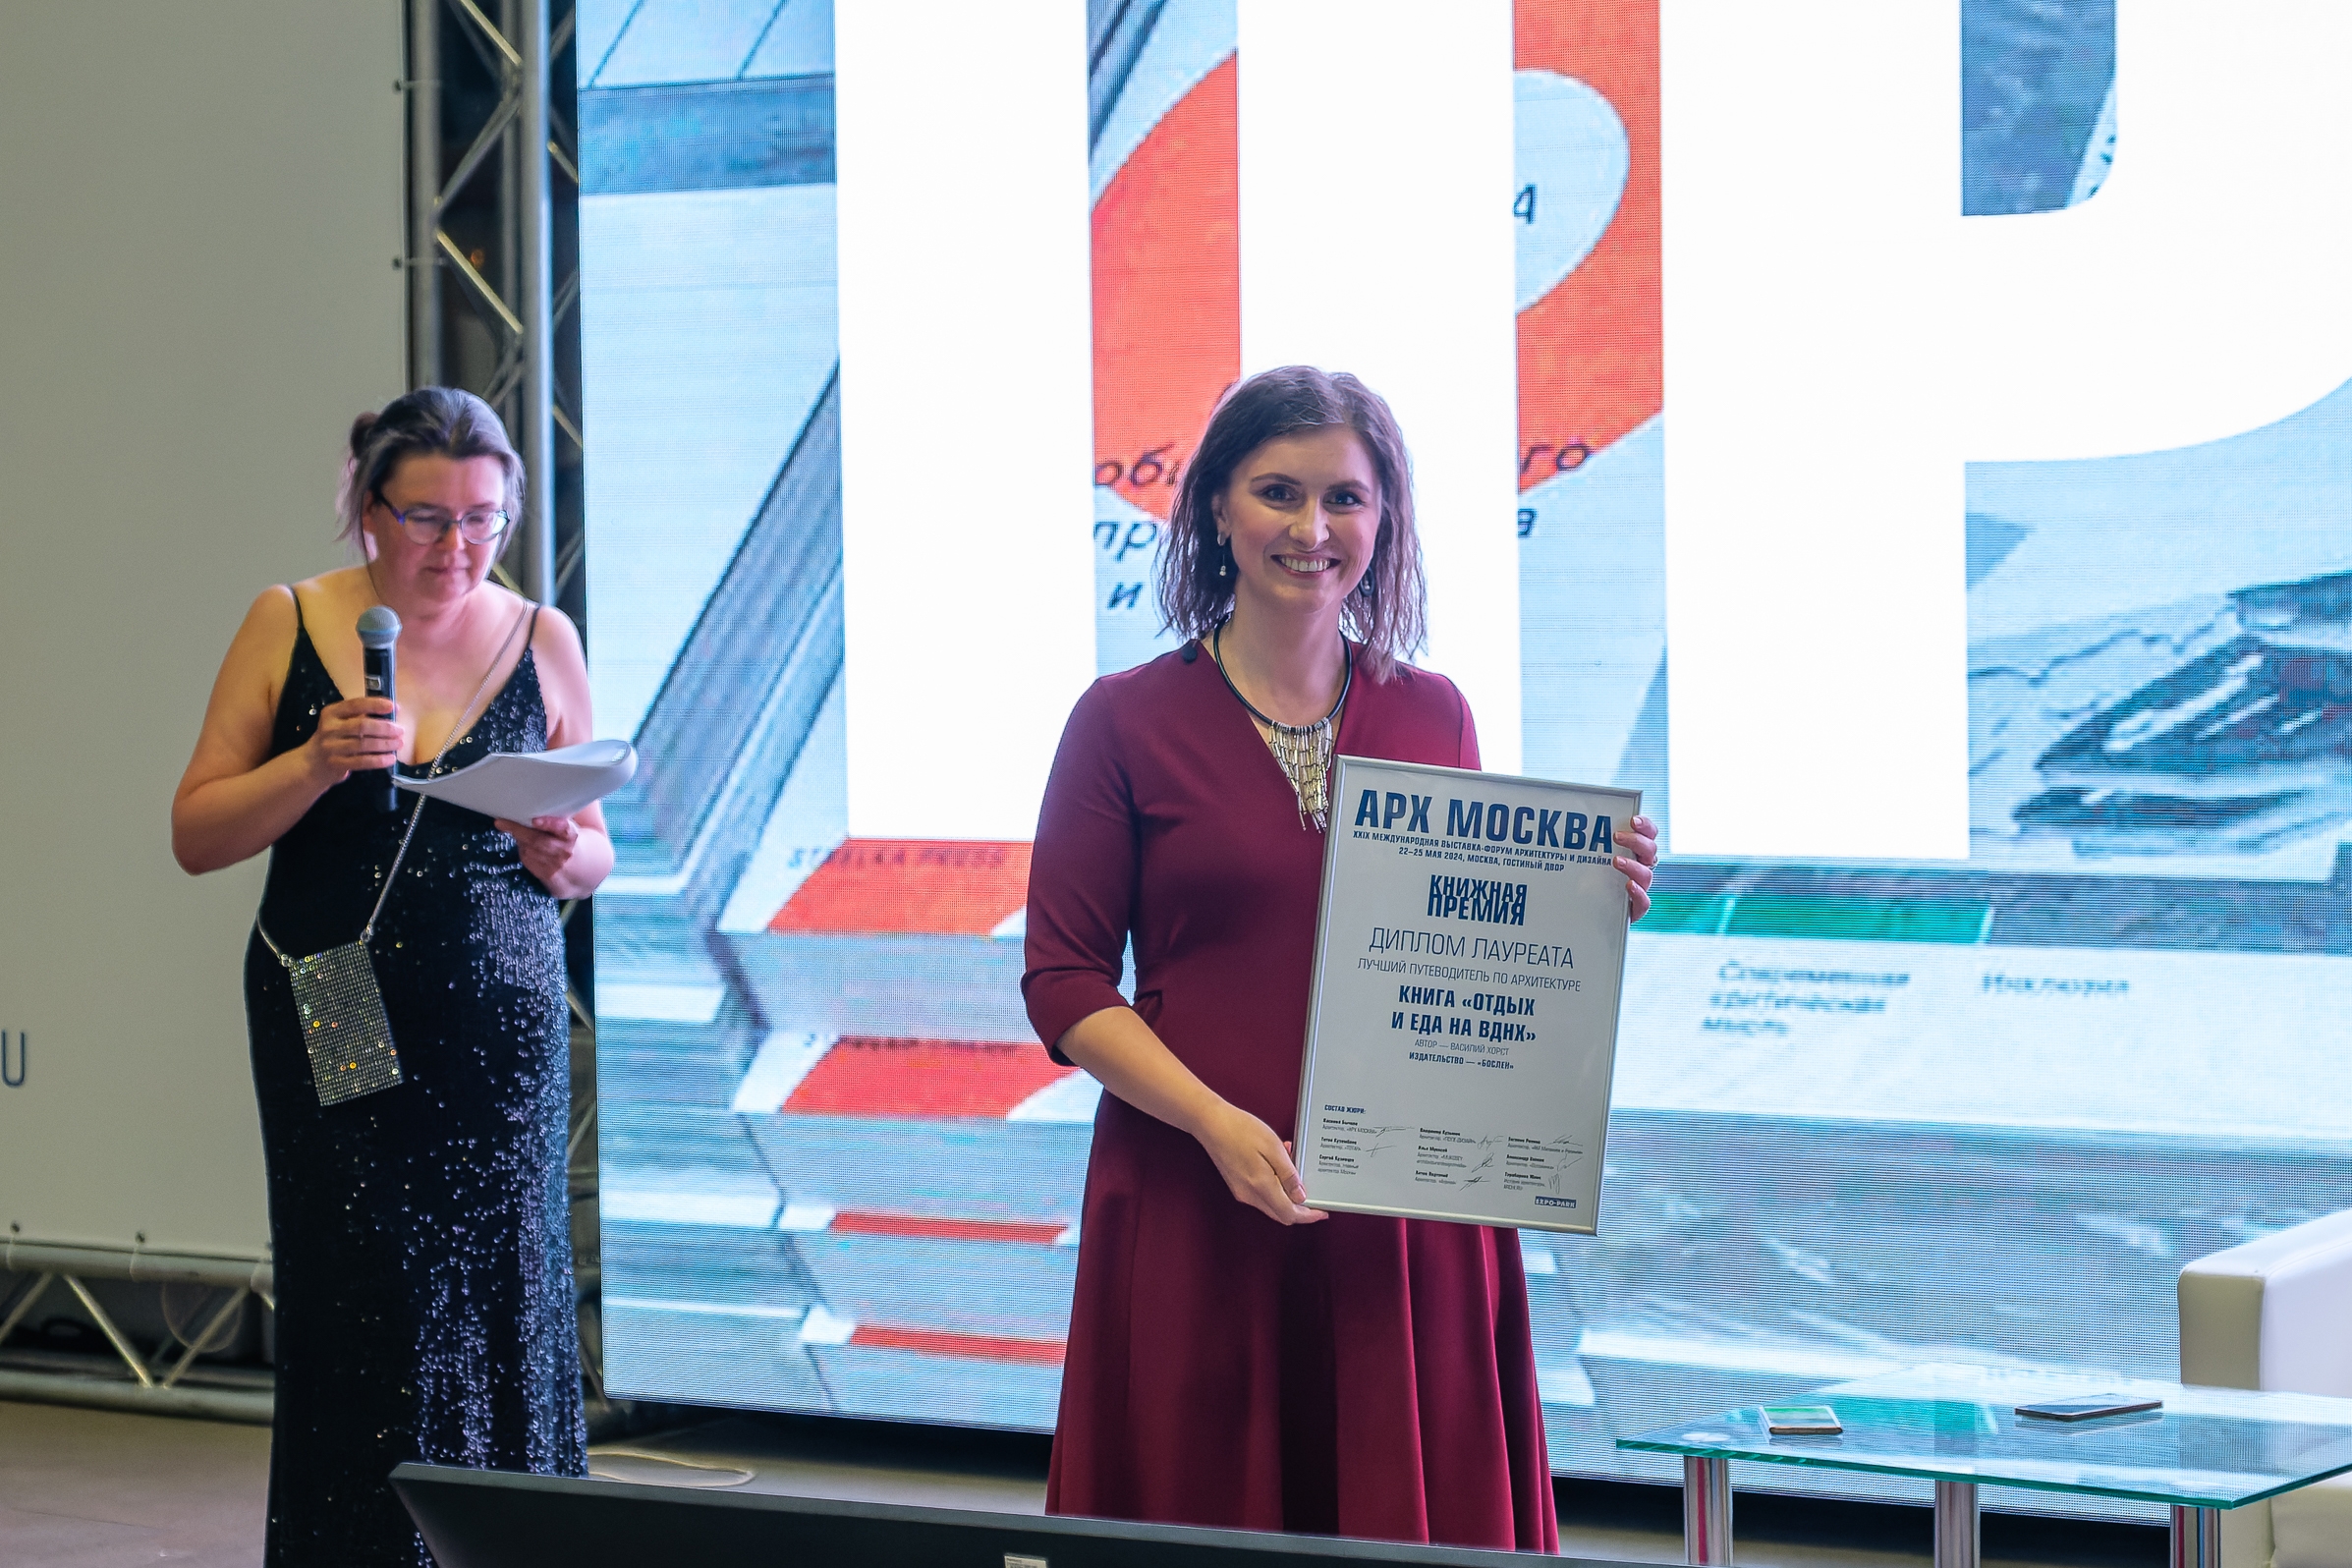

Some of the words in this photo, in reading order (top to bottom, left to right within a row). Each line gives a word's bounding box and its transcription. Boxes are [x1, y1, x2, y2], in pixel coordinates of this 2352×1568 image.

[1355, 789, 1432, 834] АРХ
[1447, 799, 1613, 854] МОСКВА
[1372, 832, 1438, 847] МЕЖДУНАРОДНАЯ
[1441, 840, 1512, 856] ВЫСТАВКА-ФОРУМ
[1515, 848, 1567, 862] АРХИТЕКТУРЫ
[1577, 855, 1612, 866] ДИЗАЙНА
[1426, 850, 1442, 859] МАЯ
[1444, 852, 1465, 863] 2024,
[1467, 854, 1500, 867] МОСКВА,
[1503, 858, 1542, 869] ГОСТИНЫЙ
[1544, 863, 1564, 871] ДВОР
[1429, 874, 1528, 904] КНИЖНАЯ
[1427, 892, 1527, 925] ПРЕМИЯ
[1369, 927, 1466, 958] ДИПЛОМ
[1472, 938, 1574, 969] ЛАУРЕАТА
[1358, 958, 1407, 975] ЛУЧШИЙ
[1409, 963, 1489, 982] ПУТЕВОДИТЕЛЬ
[1493, 973, 1508, 984] ПО
[1510, 975, 1582, 992] АРХИТЕКТУРЕ
[1398, 985, 1455, 1008] КНИГА
[1462, 992, 1536, 1017] «ОТДЫХ
[1391, 1011, 1404, 1030] И
[1410, 1013, 1442, 1036] ЕДА
[1449, 1017, 1472, 1036] НА
[1479, 1020, 1537, 1042] ВДНХ»
[1409, 1051, 1464, 1065] ИЗДАТЕЛЬСТВО
[1415, 1038, 1438, 1048] АВТОР
[1450, 1041, 1485, 1053] ВАСИЛИЙ
